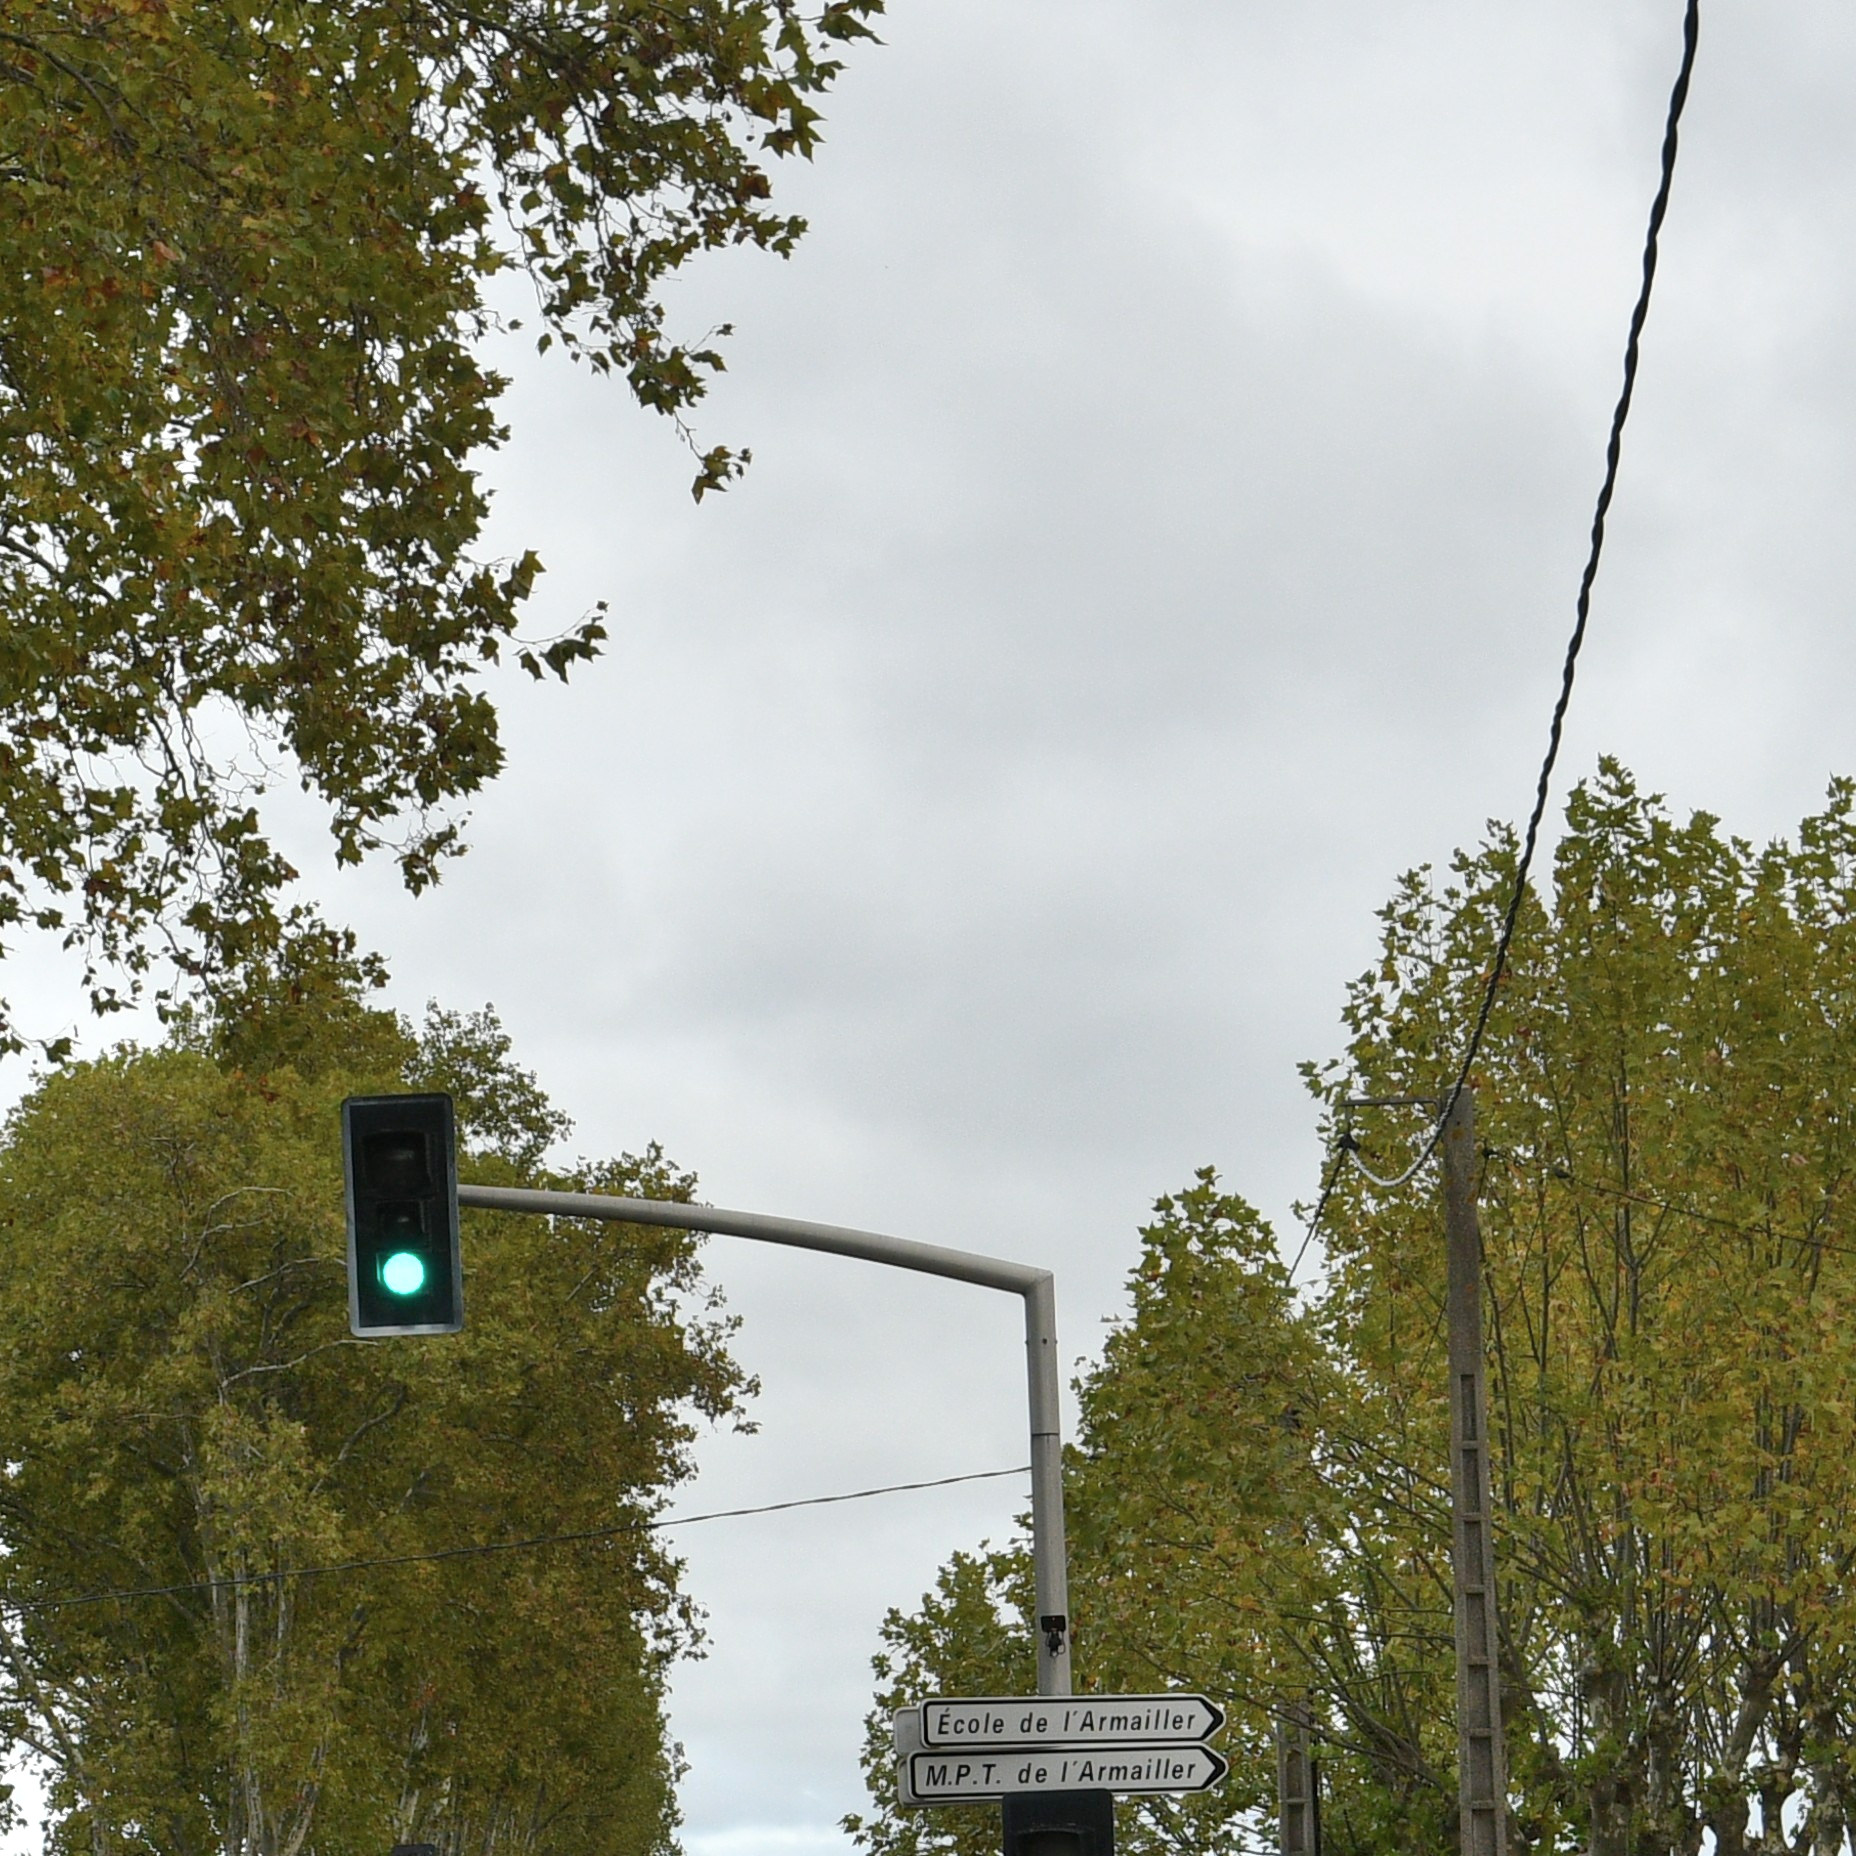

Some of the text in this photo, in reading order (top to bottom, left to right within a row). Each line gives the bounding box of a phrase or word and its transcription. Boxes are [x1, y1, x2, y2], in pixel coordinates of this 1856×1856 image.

[937, 1707, 1196, 1735] École de l'Armailler
[926, 1758, 1196, 1786] M.P.T. de l'Armailler
